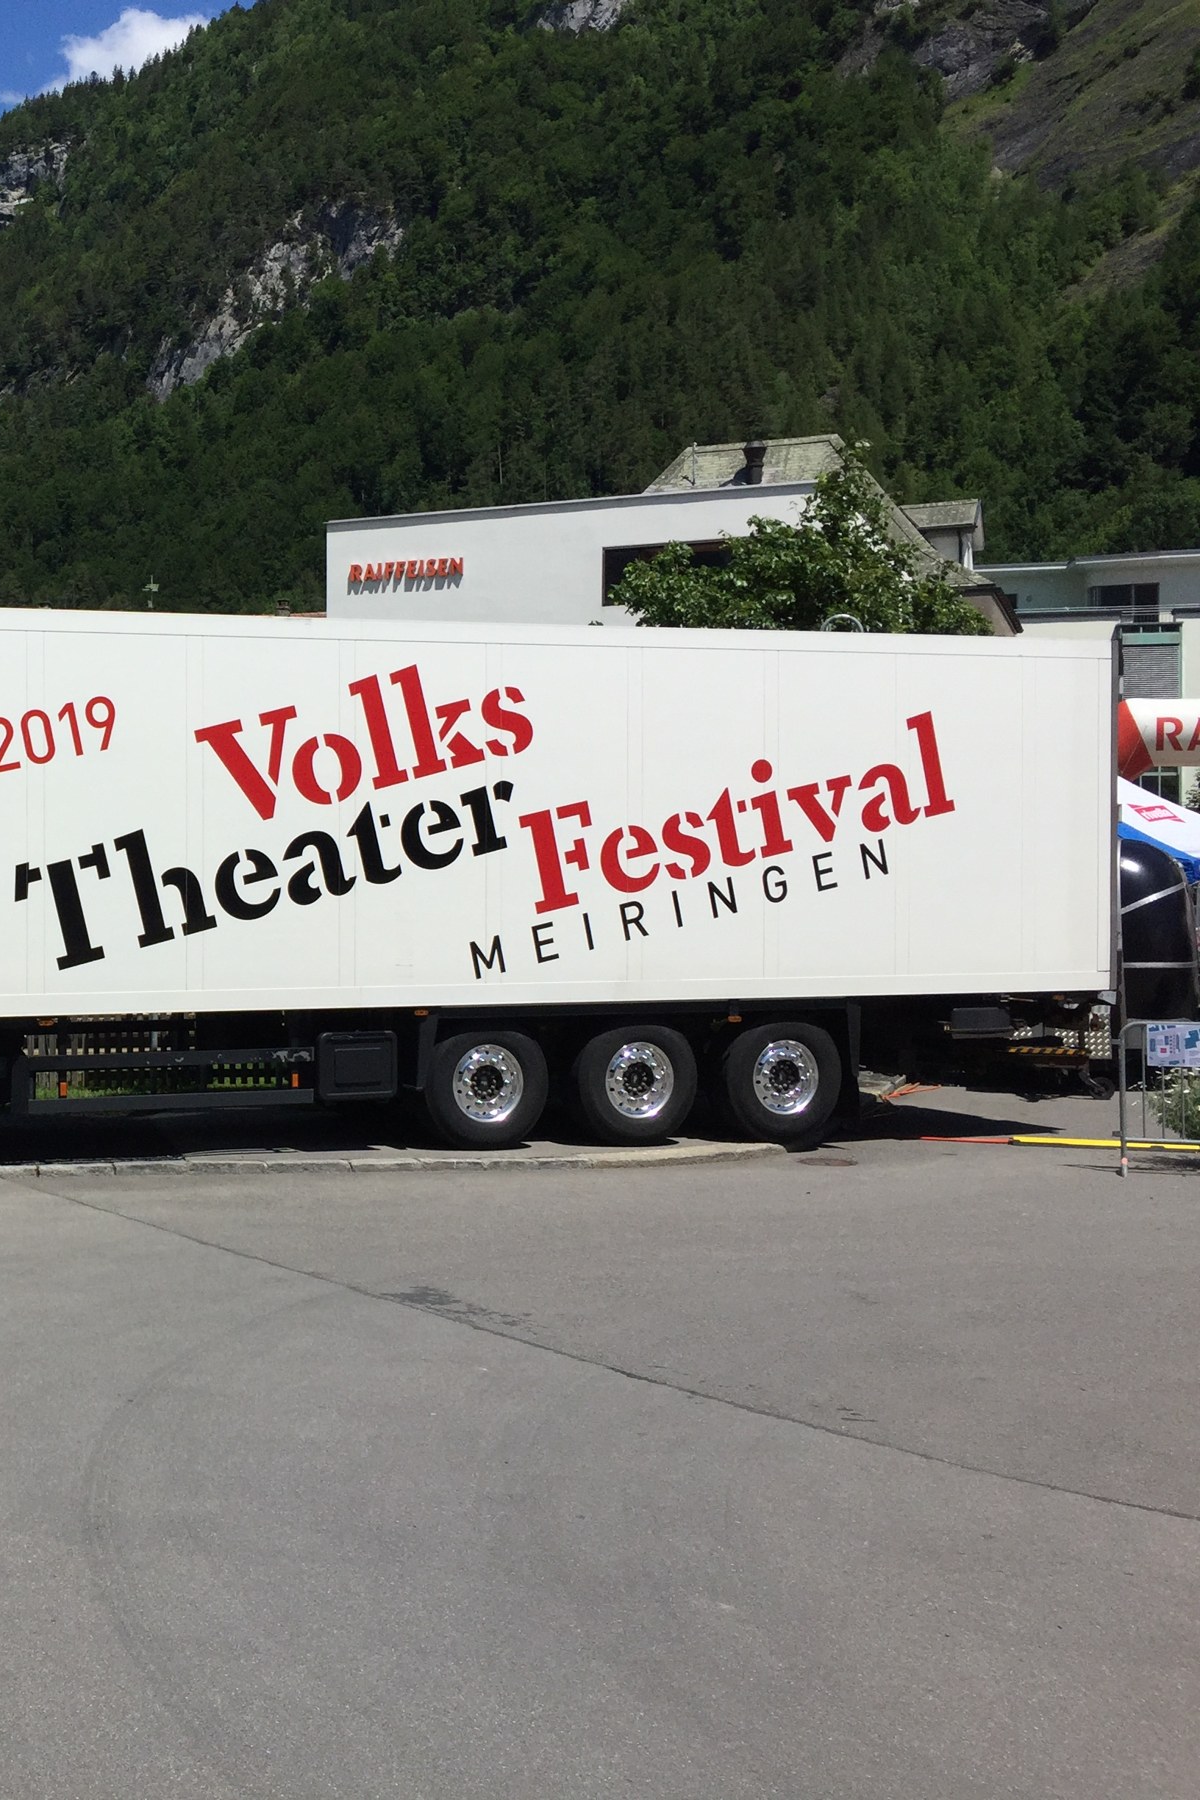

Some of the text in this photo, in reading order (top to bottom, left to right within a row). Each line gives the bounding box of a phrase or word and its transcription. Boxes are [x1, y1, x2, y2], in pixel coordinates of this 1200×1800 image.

[349, 556, 464, 583] RAIFFEISEN
[194, 664, 534, 821] Volks
[518, 711, 955, 914] Festival
[14, 780, 514, 971] Theater
[469, 838, 889, 980] MEIRINGEN
